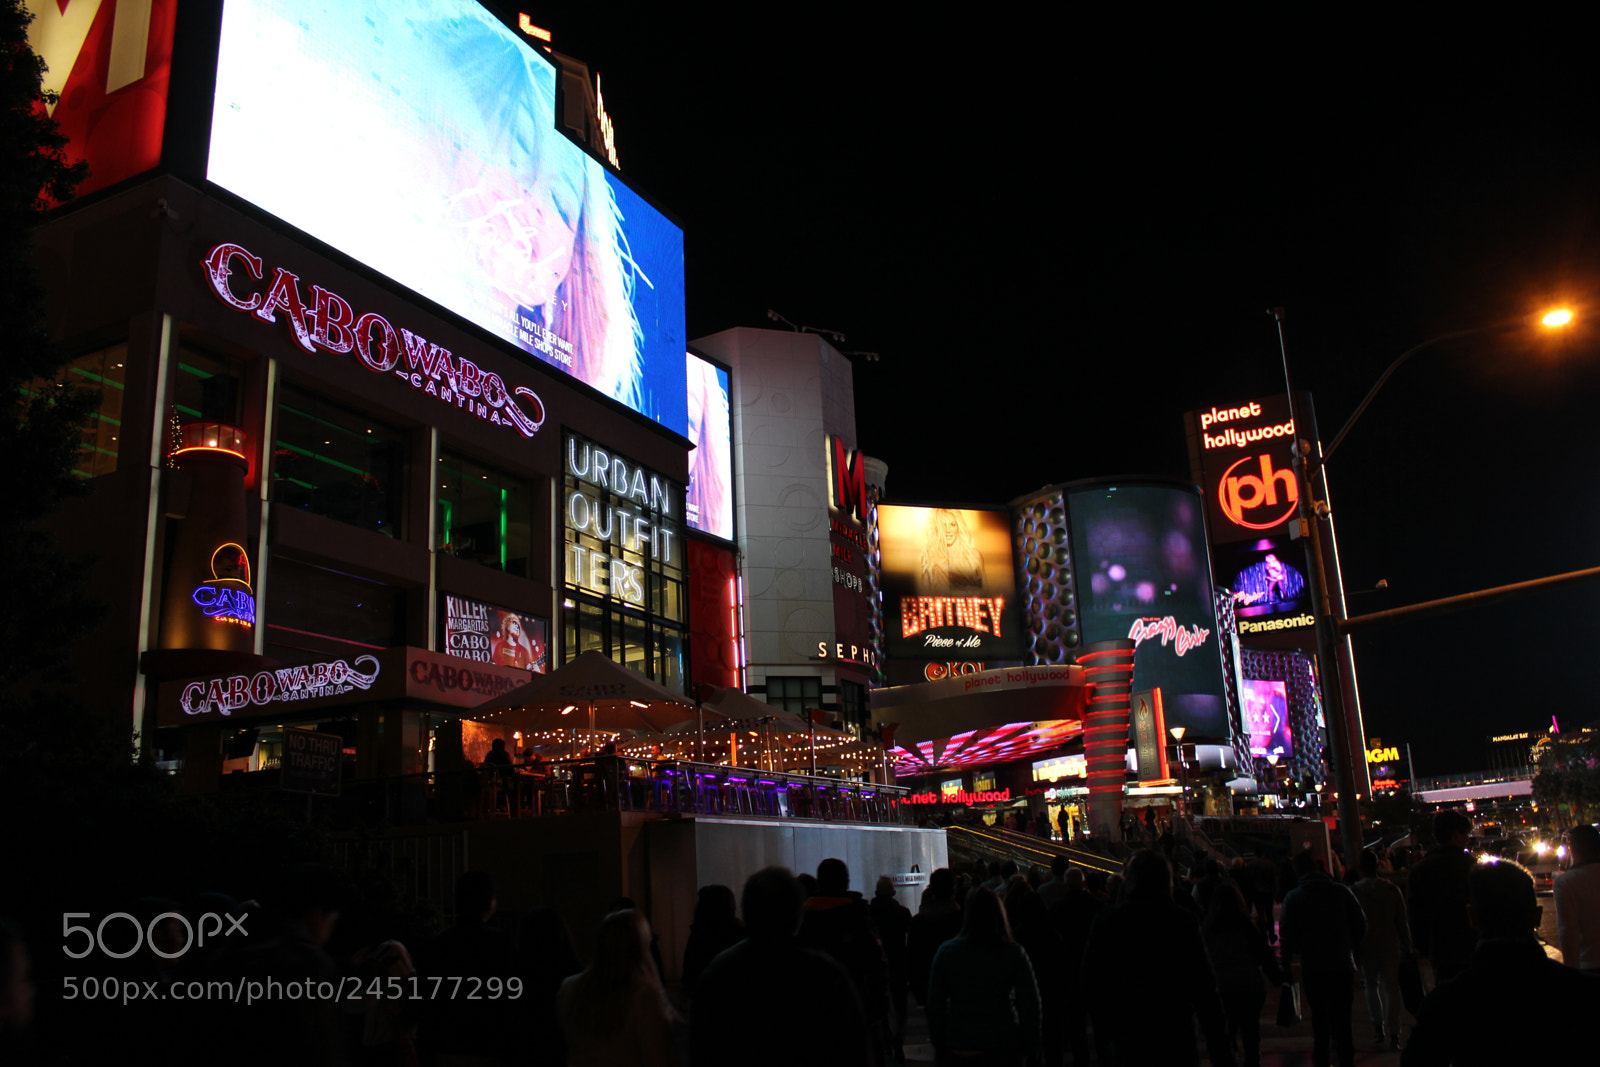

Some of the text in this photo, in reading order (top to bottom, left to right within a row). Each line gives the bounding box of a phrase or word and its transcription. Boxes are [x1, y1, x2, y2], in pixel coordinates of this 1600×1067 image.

[201, 243, 546, 437] CABO WABO
[521, 316, 541, 336] YOU'LL
[542, 328, 557, 345] EVER
[520, 328, 533, 346] MILE
[534, 337, 554, 357] SHOPS
[555, 348, 573, 367] STORE
[410, 372, 502, 425] CANTINA
[1201, 402, 1262, 430] planet
[1203, 419, 1295, 449] hollywood
[569, 437, 669, 514] URBAN
[1225, 453, 1299, 526] ph
[569, 493, 674, 562] OUTFIT
[831, 517, 868, 548] MIRACLE
[832, 542, 852, 563] MILE
[571, 545, 644, 602] TERS
[832, 565, 863, 593] SHOPS
[446, 595, 488, 620] KILLER
[901, 595, 1003, 638] BRITNEY
[448, 618, 489, 632] MARGARITAS
[1239, 613, 1315, 634] Panasonic
[449, 634, 490, 650] CABO
[924, 634, 982, 648] Piece of Me
[180, 655, 381, 715] CABO WABO
[410, 660, 474, 692] CABO
[965, 670, 1070, 691] planet hollywood
[281, 684, 345, 702] CANTINA
[289, 733, 338, 756] NO THRU
[290, 751, 336, 772] TRAFFIC
[941, 787, 1010, 807] hollywood
